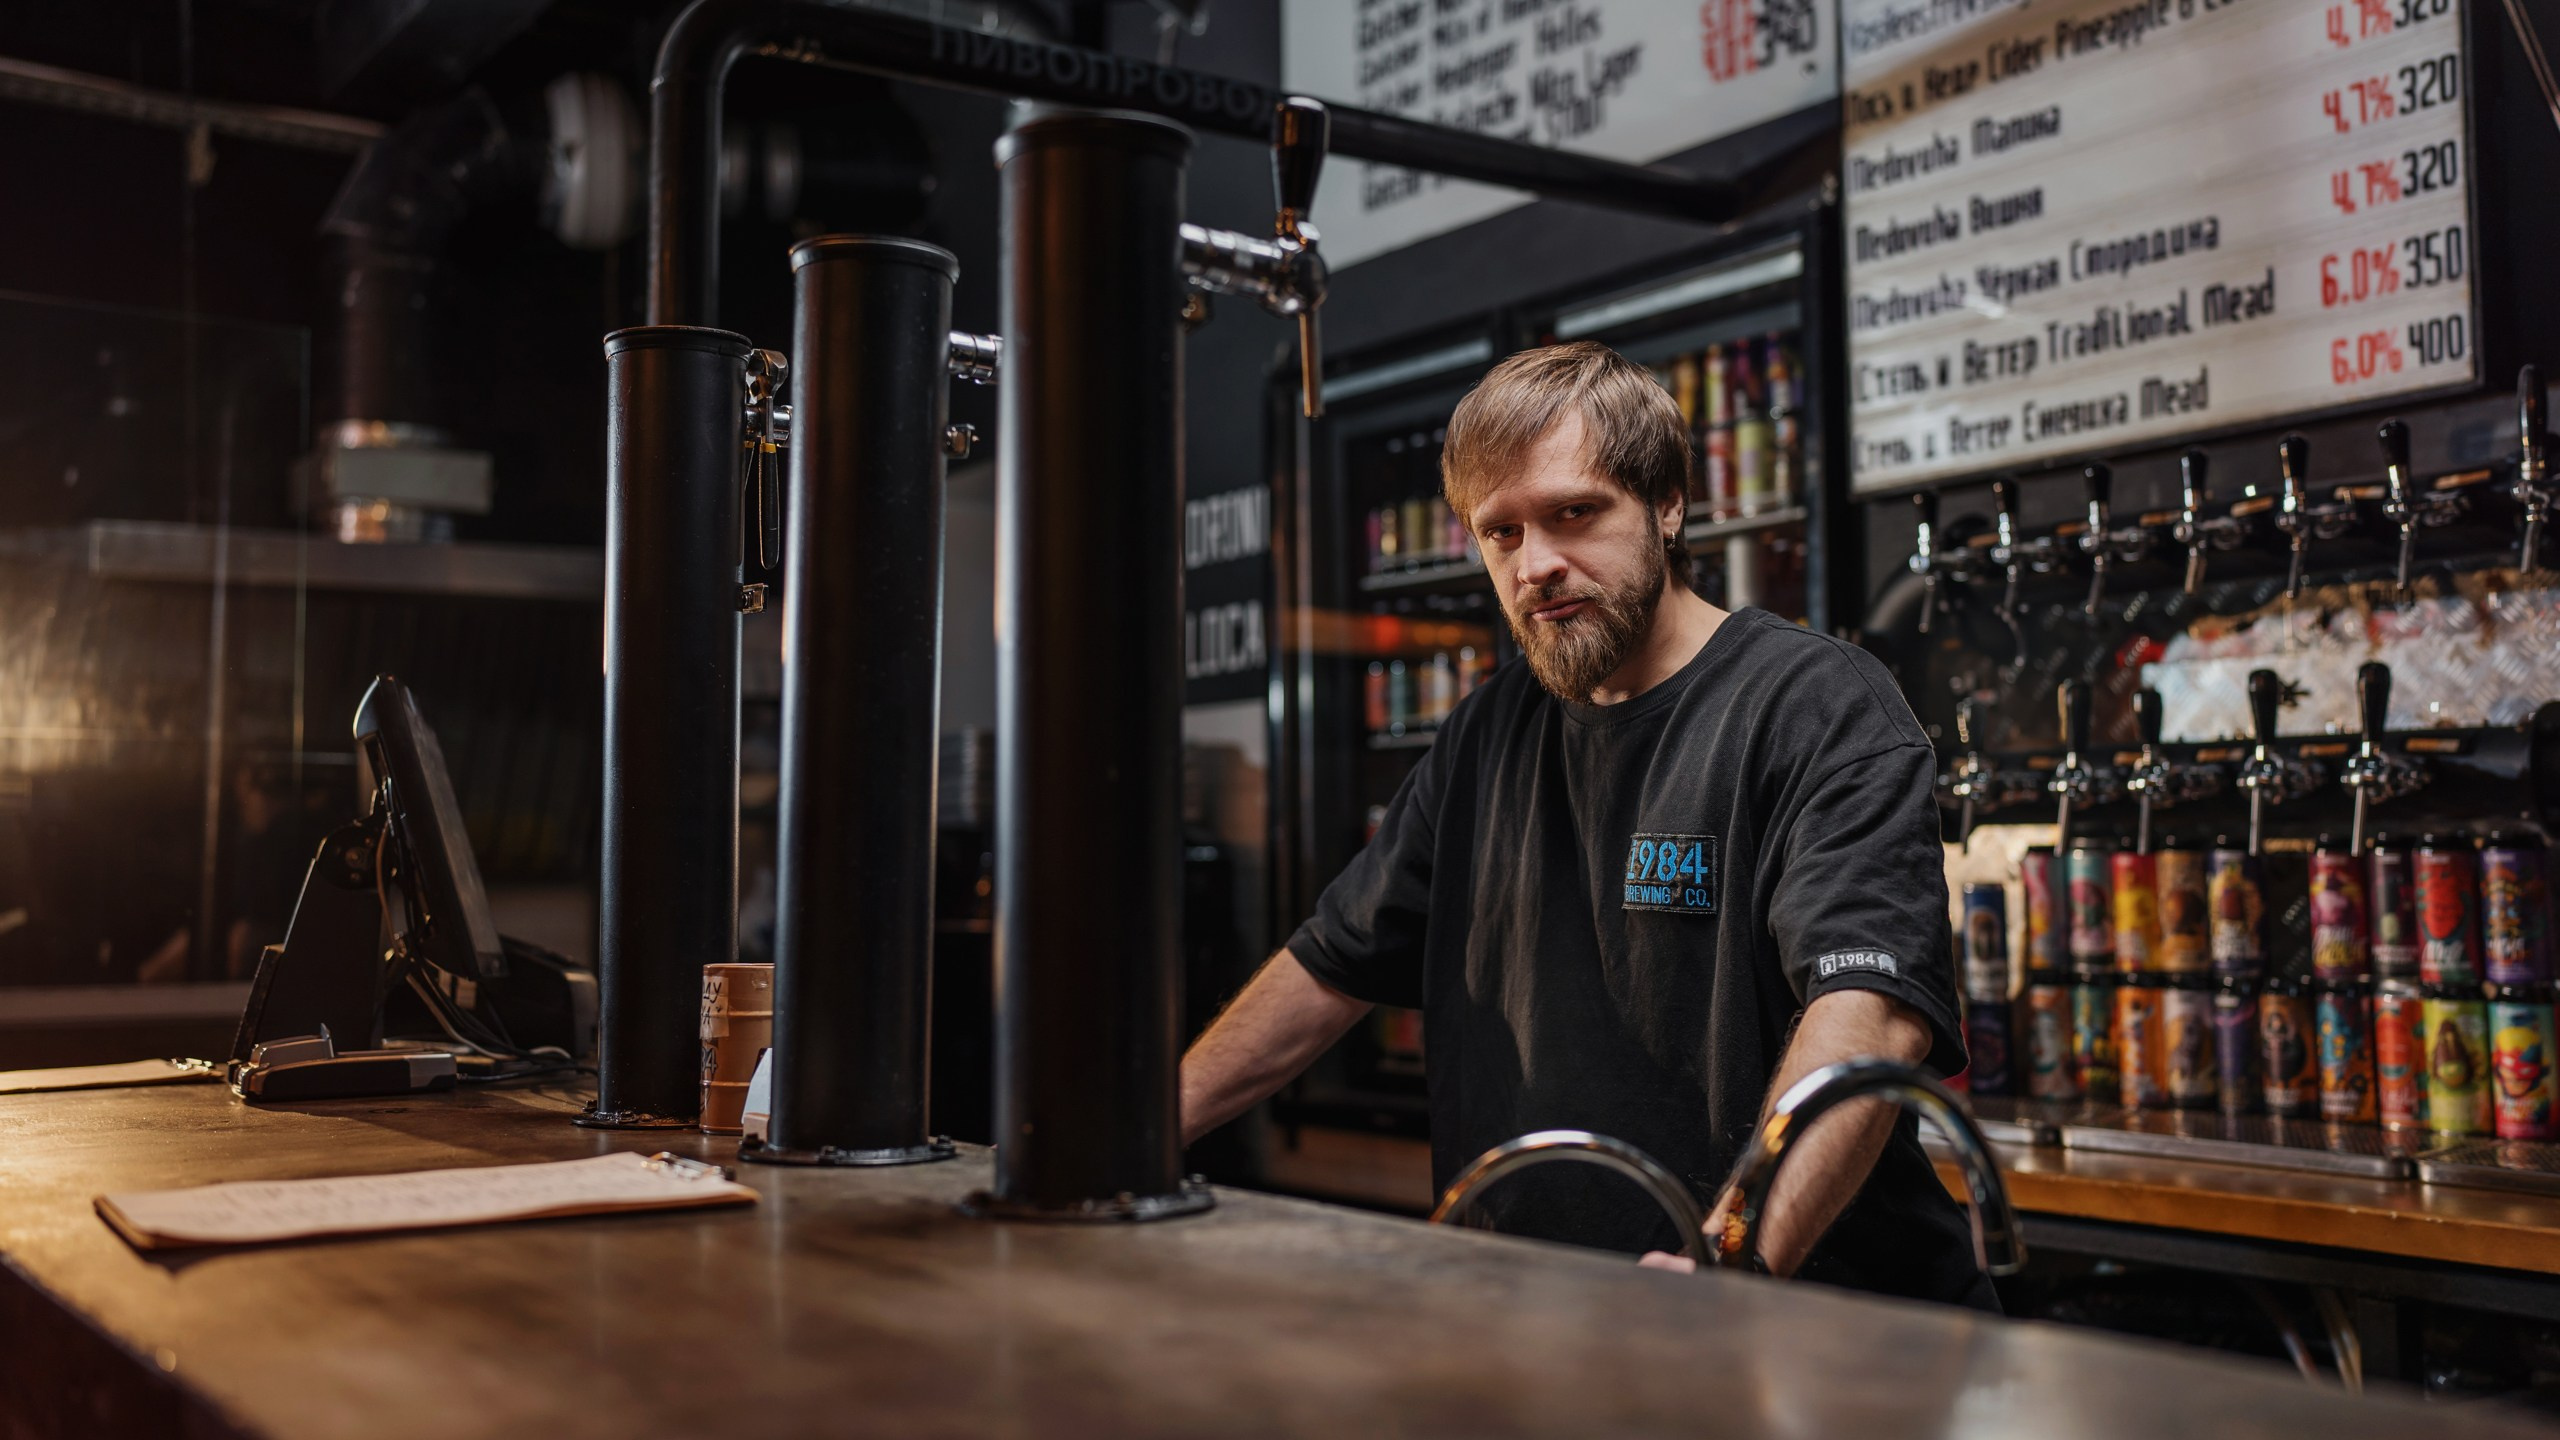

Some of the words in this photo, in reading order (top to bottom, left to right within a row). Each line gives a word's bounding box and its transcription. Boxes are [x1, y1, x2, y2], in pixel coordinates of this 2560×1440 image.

[1987, 35, 2047, 84] Cider
[2054, 0, 2171, 61] Pineapple
[2323, 74, 2394, 134] 4.7%
[2398, 54, 2457, 116] 320
[2332, 160, 2401, 215] 4.7%
[2402, 140, 2457, 197] 320
[2202, 266, 2275, 328] Mead
[2320, 243, 2399, 309] 6.0%
[2403, 226, 2462, 289] 350
[2140, 364, 2209, 420] Mead
[2331, 327, 2403, 384] 6.0%
[2408, 314, 2464, 368] 400
[1625, 885, 1671, 905] BREWING
[1685, 888, 1711, 907] CO.
[1627, 839, 1708, 884] 1984
[1838, 953, 1875, 967] 1984
